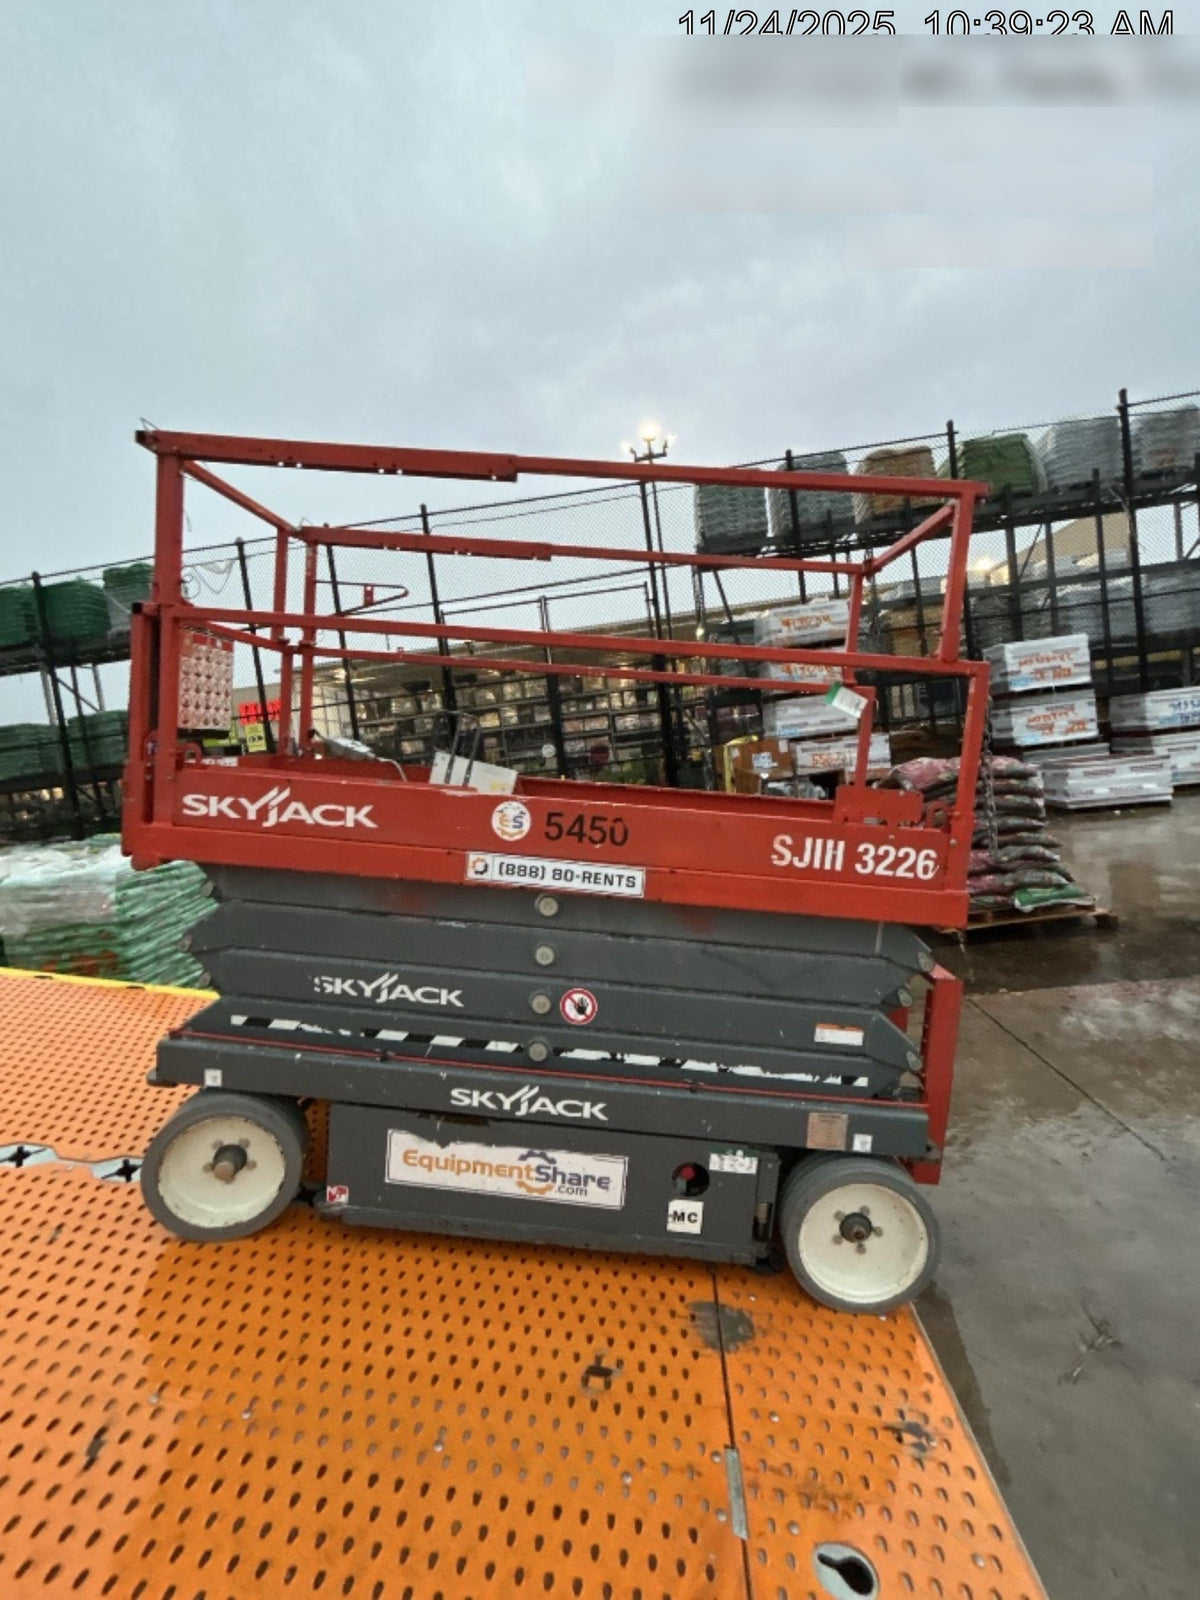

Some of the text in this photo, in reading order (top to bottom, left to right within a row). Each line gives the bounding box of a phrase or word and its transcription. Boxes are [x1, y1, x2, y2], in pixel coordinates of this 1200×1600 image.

[181, 785, 379, 829] SKYJACK
[544, 811, 629, 846] 5450
[498, 861, 637, 889] (888) 80-RENTS
[854, 842, 938, 880] 3226
[313, 971, 464, 1008] SKYJACK
[450, 1084, 609, 1121] SKYJACK
[554, 1183, 588, 1197] .com
